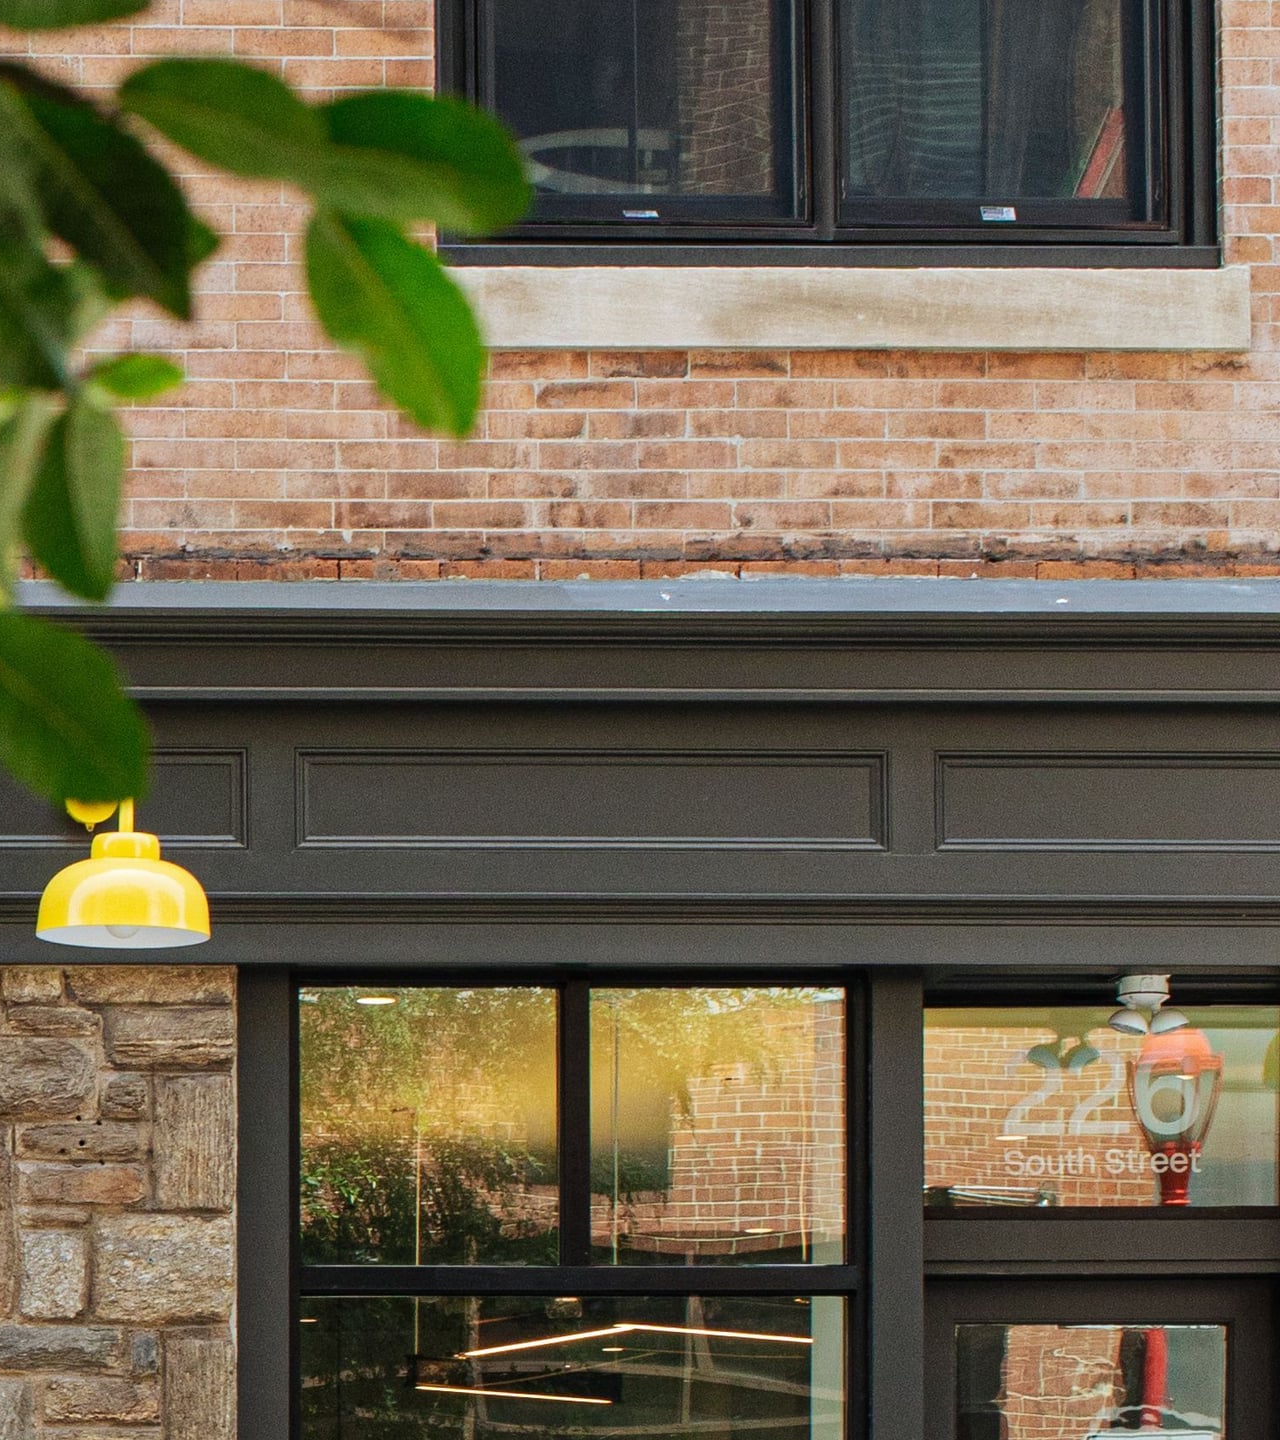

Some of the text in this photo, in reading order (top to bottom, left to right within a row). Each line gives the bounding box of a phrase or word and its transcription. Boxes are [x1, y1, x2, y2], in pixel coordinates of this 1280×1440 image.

[1003, 1049, 1200, 1136] 226
[1003, 1147, 1202, 1176] South Street
